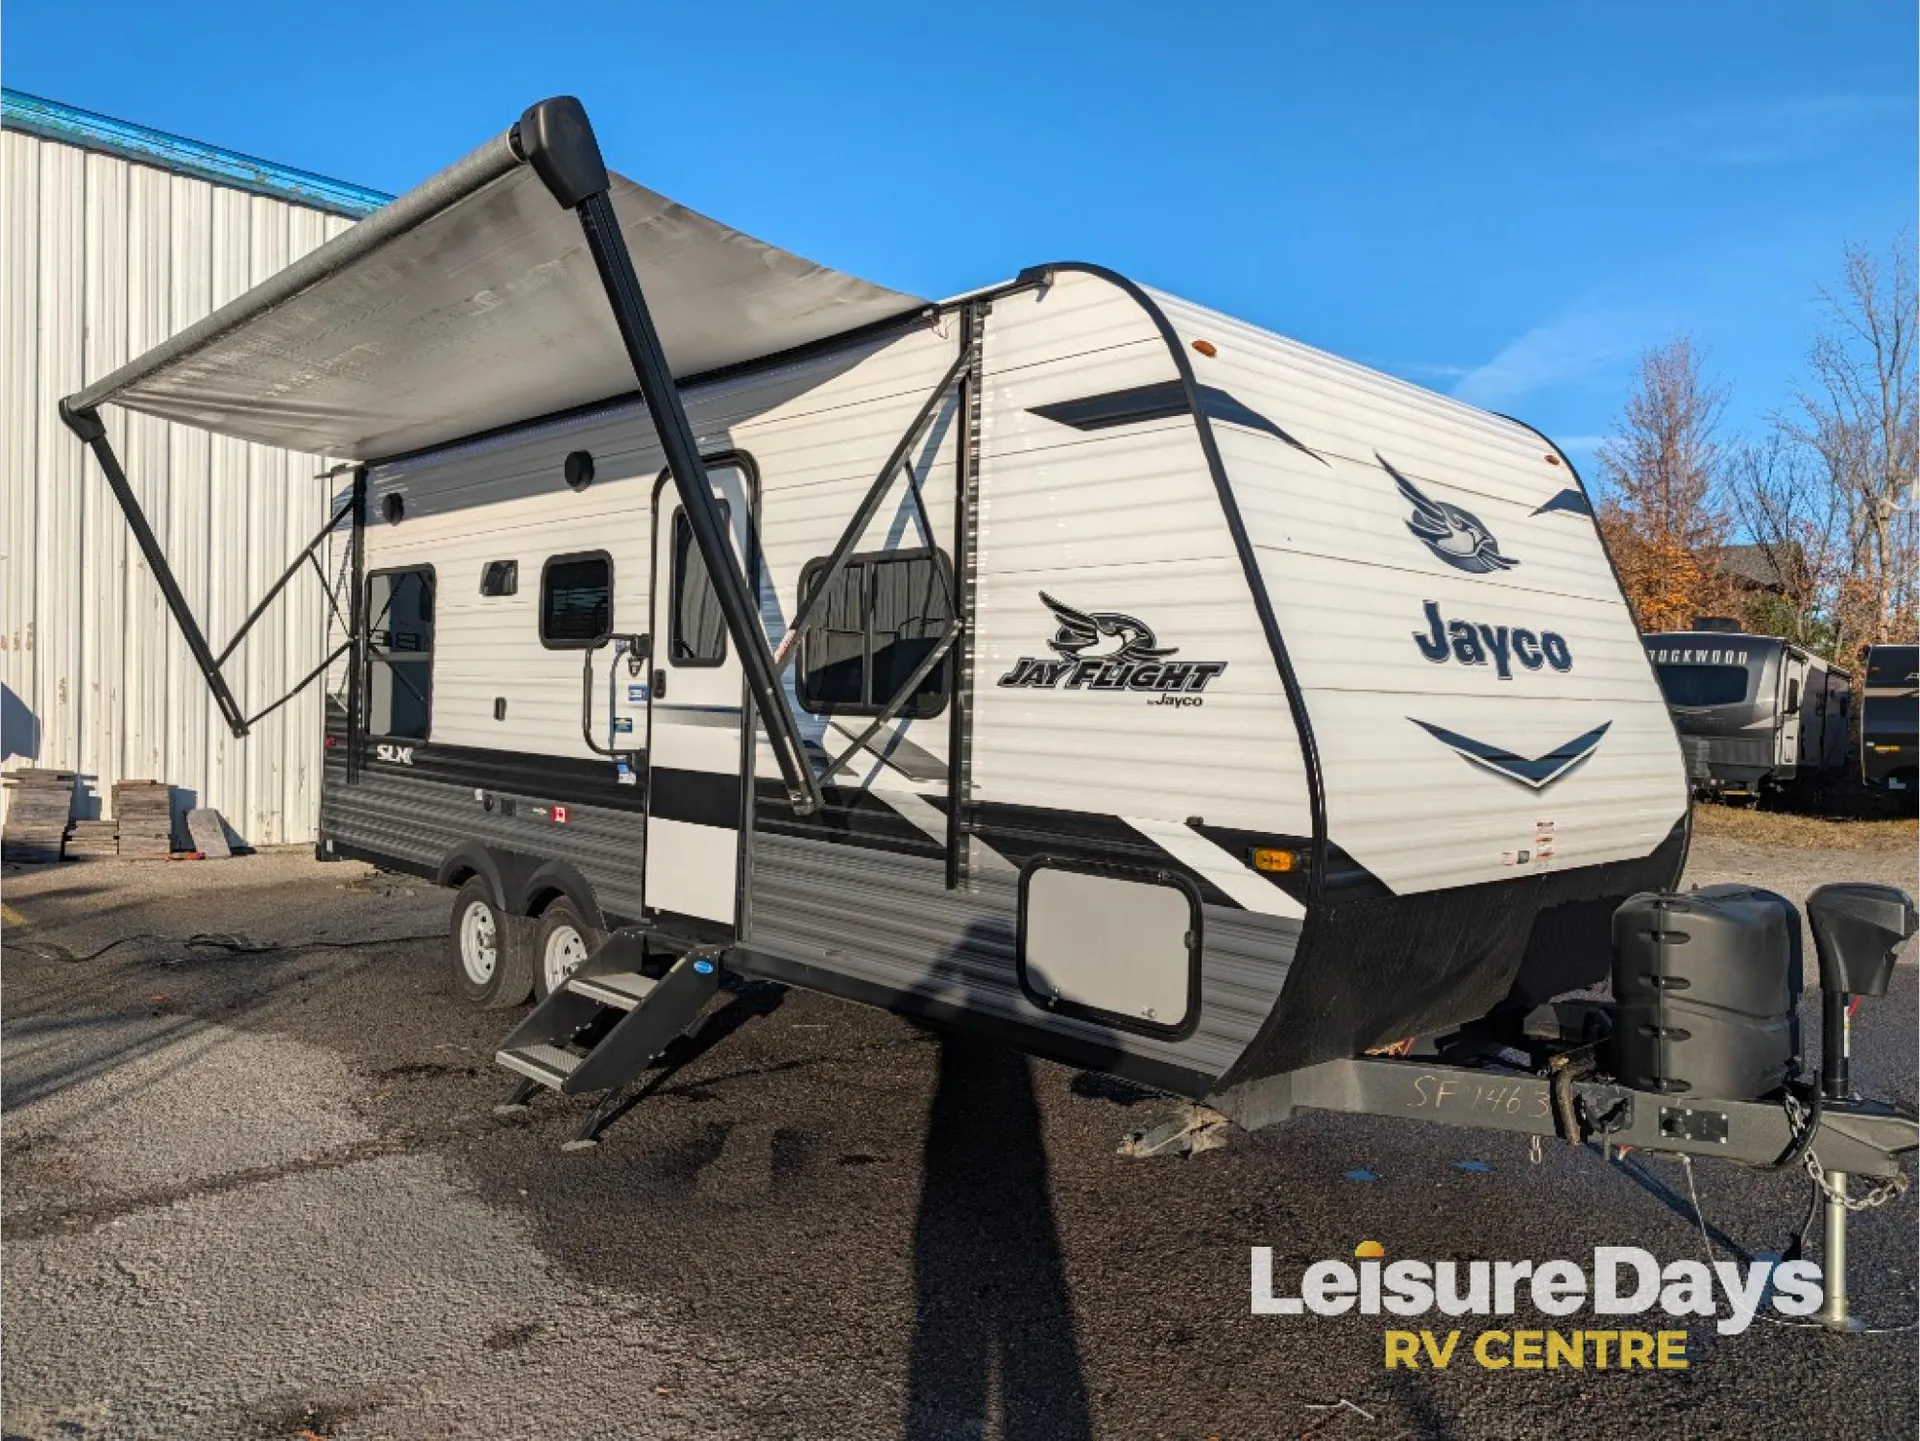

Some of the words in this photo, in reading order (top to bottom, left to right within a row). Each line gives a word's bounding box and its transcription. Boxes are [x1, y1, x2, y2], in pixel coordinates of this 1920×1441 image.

[1412, 600, 1573, 680] Jayco
[997, 657, 1073, 687] JAY
[1063, 659, 1229, 692] FLIGHT
[1155, 692, 1204, 709] Jayco
[1406, 1075, 1460, 1109] SF
